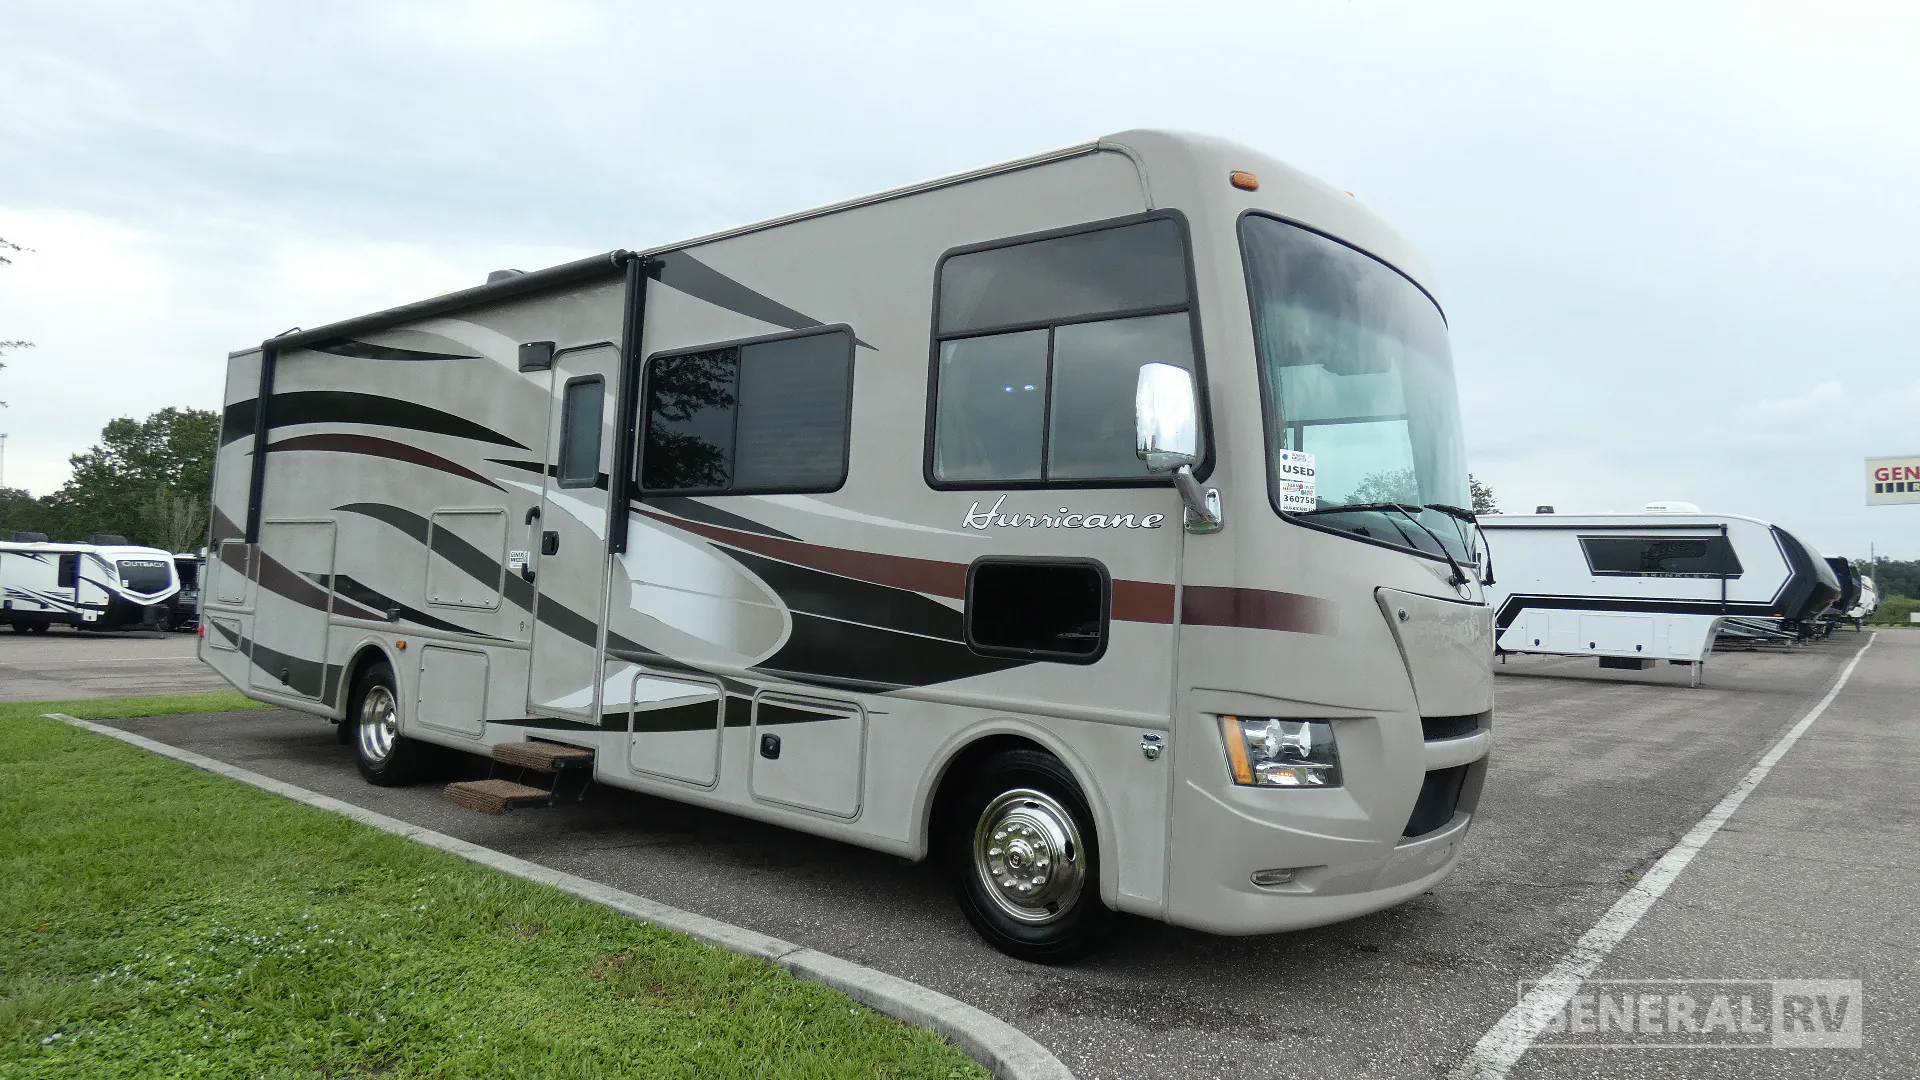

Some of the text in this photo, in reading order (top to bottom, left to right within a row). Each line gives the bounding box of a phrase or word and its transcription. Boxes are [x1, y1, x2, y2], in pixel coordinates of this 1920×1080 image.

[1283, 465, 1315, 476] USED
[1875, 466, 1920, 481] GEN
[1283, 495, 1315, 504] 360758
[962, 494, 1165, 530] Hurricane
